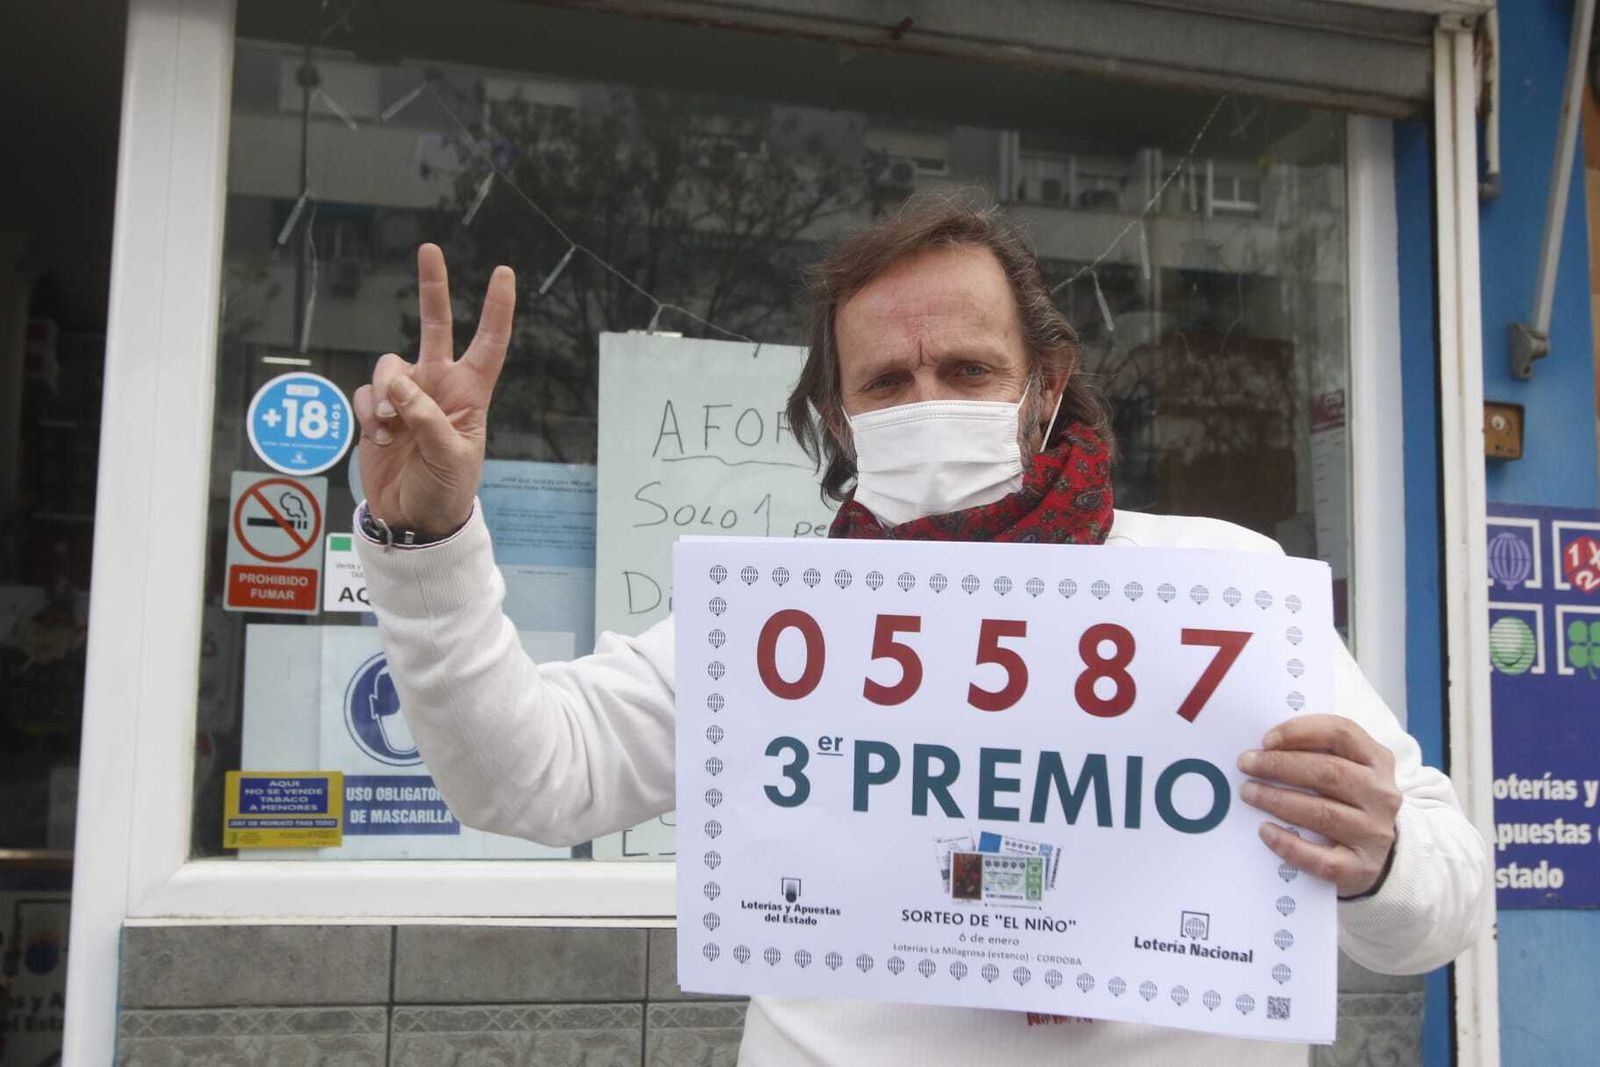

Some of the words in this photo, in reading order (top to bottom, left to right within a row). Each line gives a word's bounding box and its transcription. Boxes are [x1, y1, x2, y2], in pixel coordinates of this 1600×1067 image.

[262, 399, 329, 439] +18
[330, 404, 341, 439] AÑOS
[239, 573, 309, 587] PROHIBIDO
[251, 588, 295, 600] FUMAR
[757, 609, 1253, 723] 05587
[346, 787, 372, 801] USO
[853, 739, 1231, 834] PREMIO
[1584, 780, 1599, 808] y
[350, 809, 367, 824] DE
[370, 809, 453, 824] MASCARILLA
[785, 905, 791, 914] y
[794, 904, 841, 916] Apuestas
[764, 913, 780, 923] del
[782, 914, 817, 925] Estado
[902, 909, 964, 925] SORTEO
[969, 914, 989, 927] DE
[958, 933, 967, 942] 6
[970, 933, 985, 943] de
[988, 937, 1020, 946] enero
[930, 945, 940, 954] La
[942, 947, 986, 959] Milagrosa
[1190, 943, 1253, 963] Nacional
